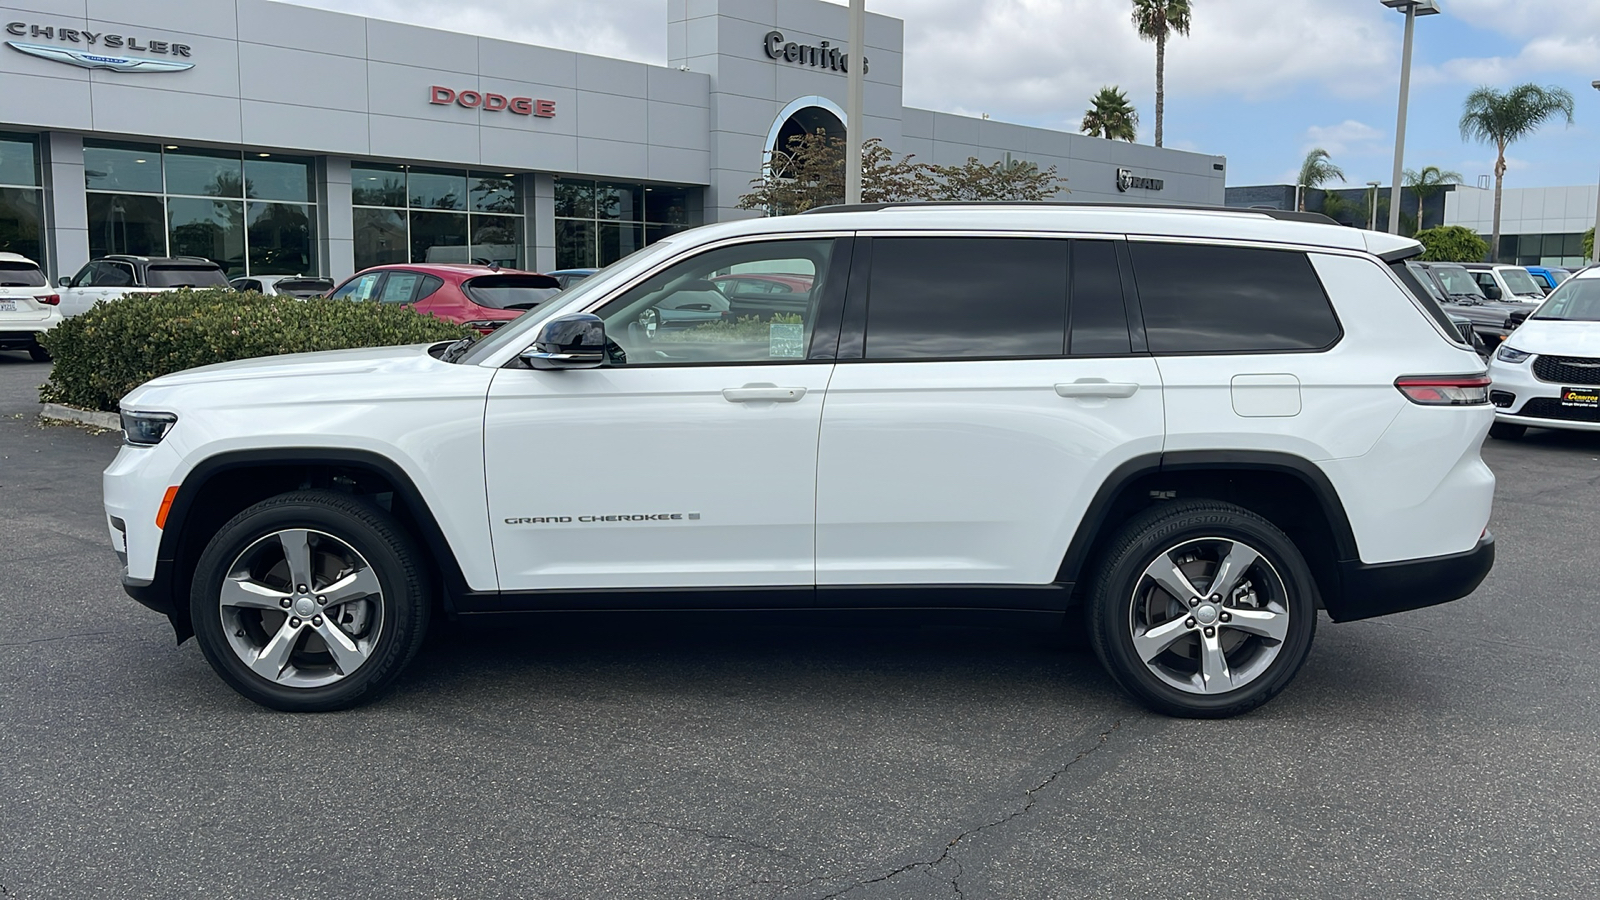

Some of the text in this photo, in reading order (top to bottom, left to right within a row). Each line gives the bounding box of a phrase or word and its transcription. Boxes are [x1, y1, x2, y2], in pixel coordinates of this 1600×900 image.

[6, 22, 192, 58] CHRYSLER
[429, 85, 556, 118] DODGE
[1131, 176, 1164, 191] RAM
[504, 516, 573, 525] GRAND
[578, 513, 683, 523] CHEROKEE
[1147, 515, 1236, 543] BRIDGESTONE
